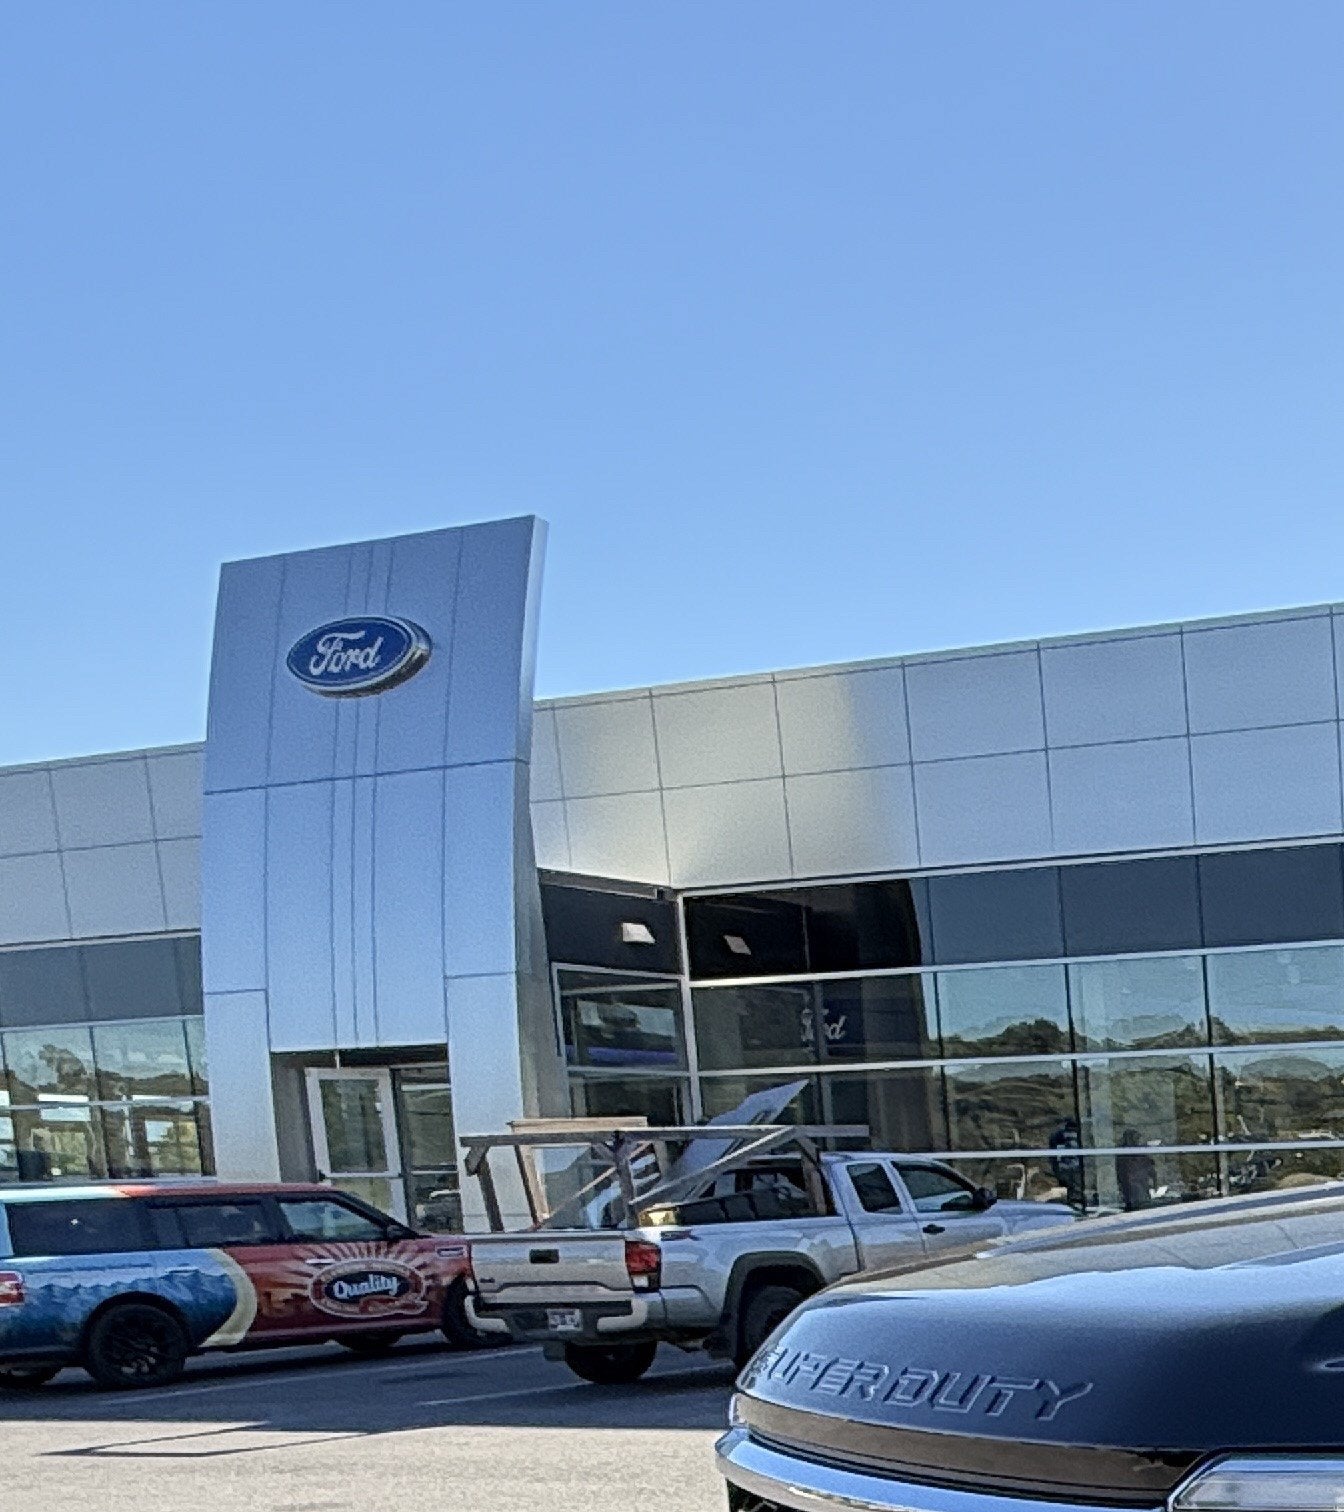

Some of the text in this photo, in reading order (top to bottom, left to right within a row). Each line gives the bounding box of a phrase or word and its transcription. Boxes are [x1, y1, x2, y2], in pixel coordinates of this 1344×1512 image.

[309, 630, 383, 676] Ford
[801, 1008, 847, 1041] Frd
[333, 1274, 398, 1299] Quality
[884, 1366, 1094, 1422] DUTY
